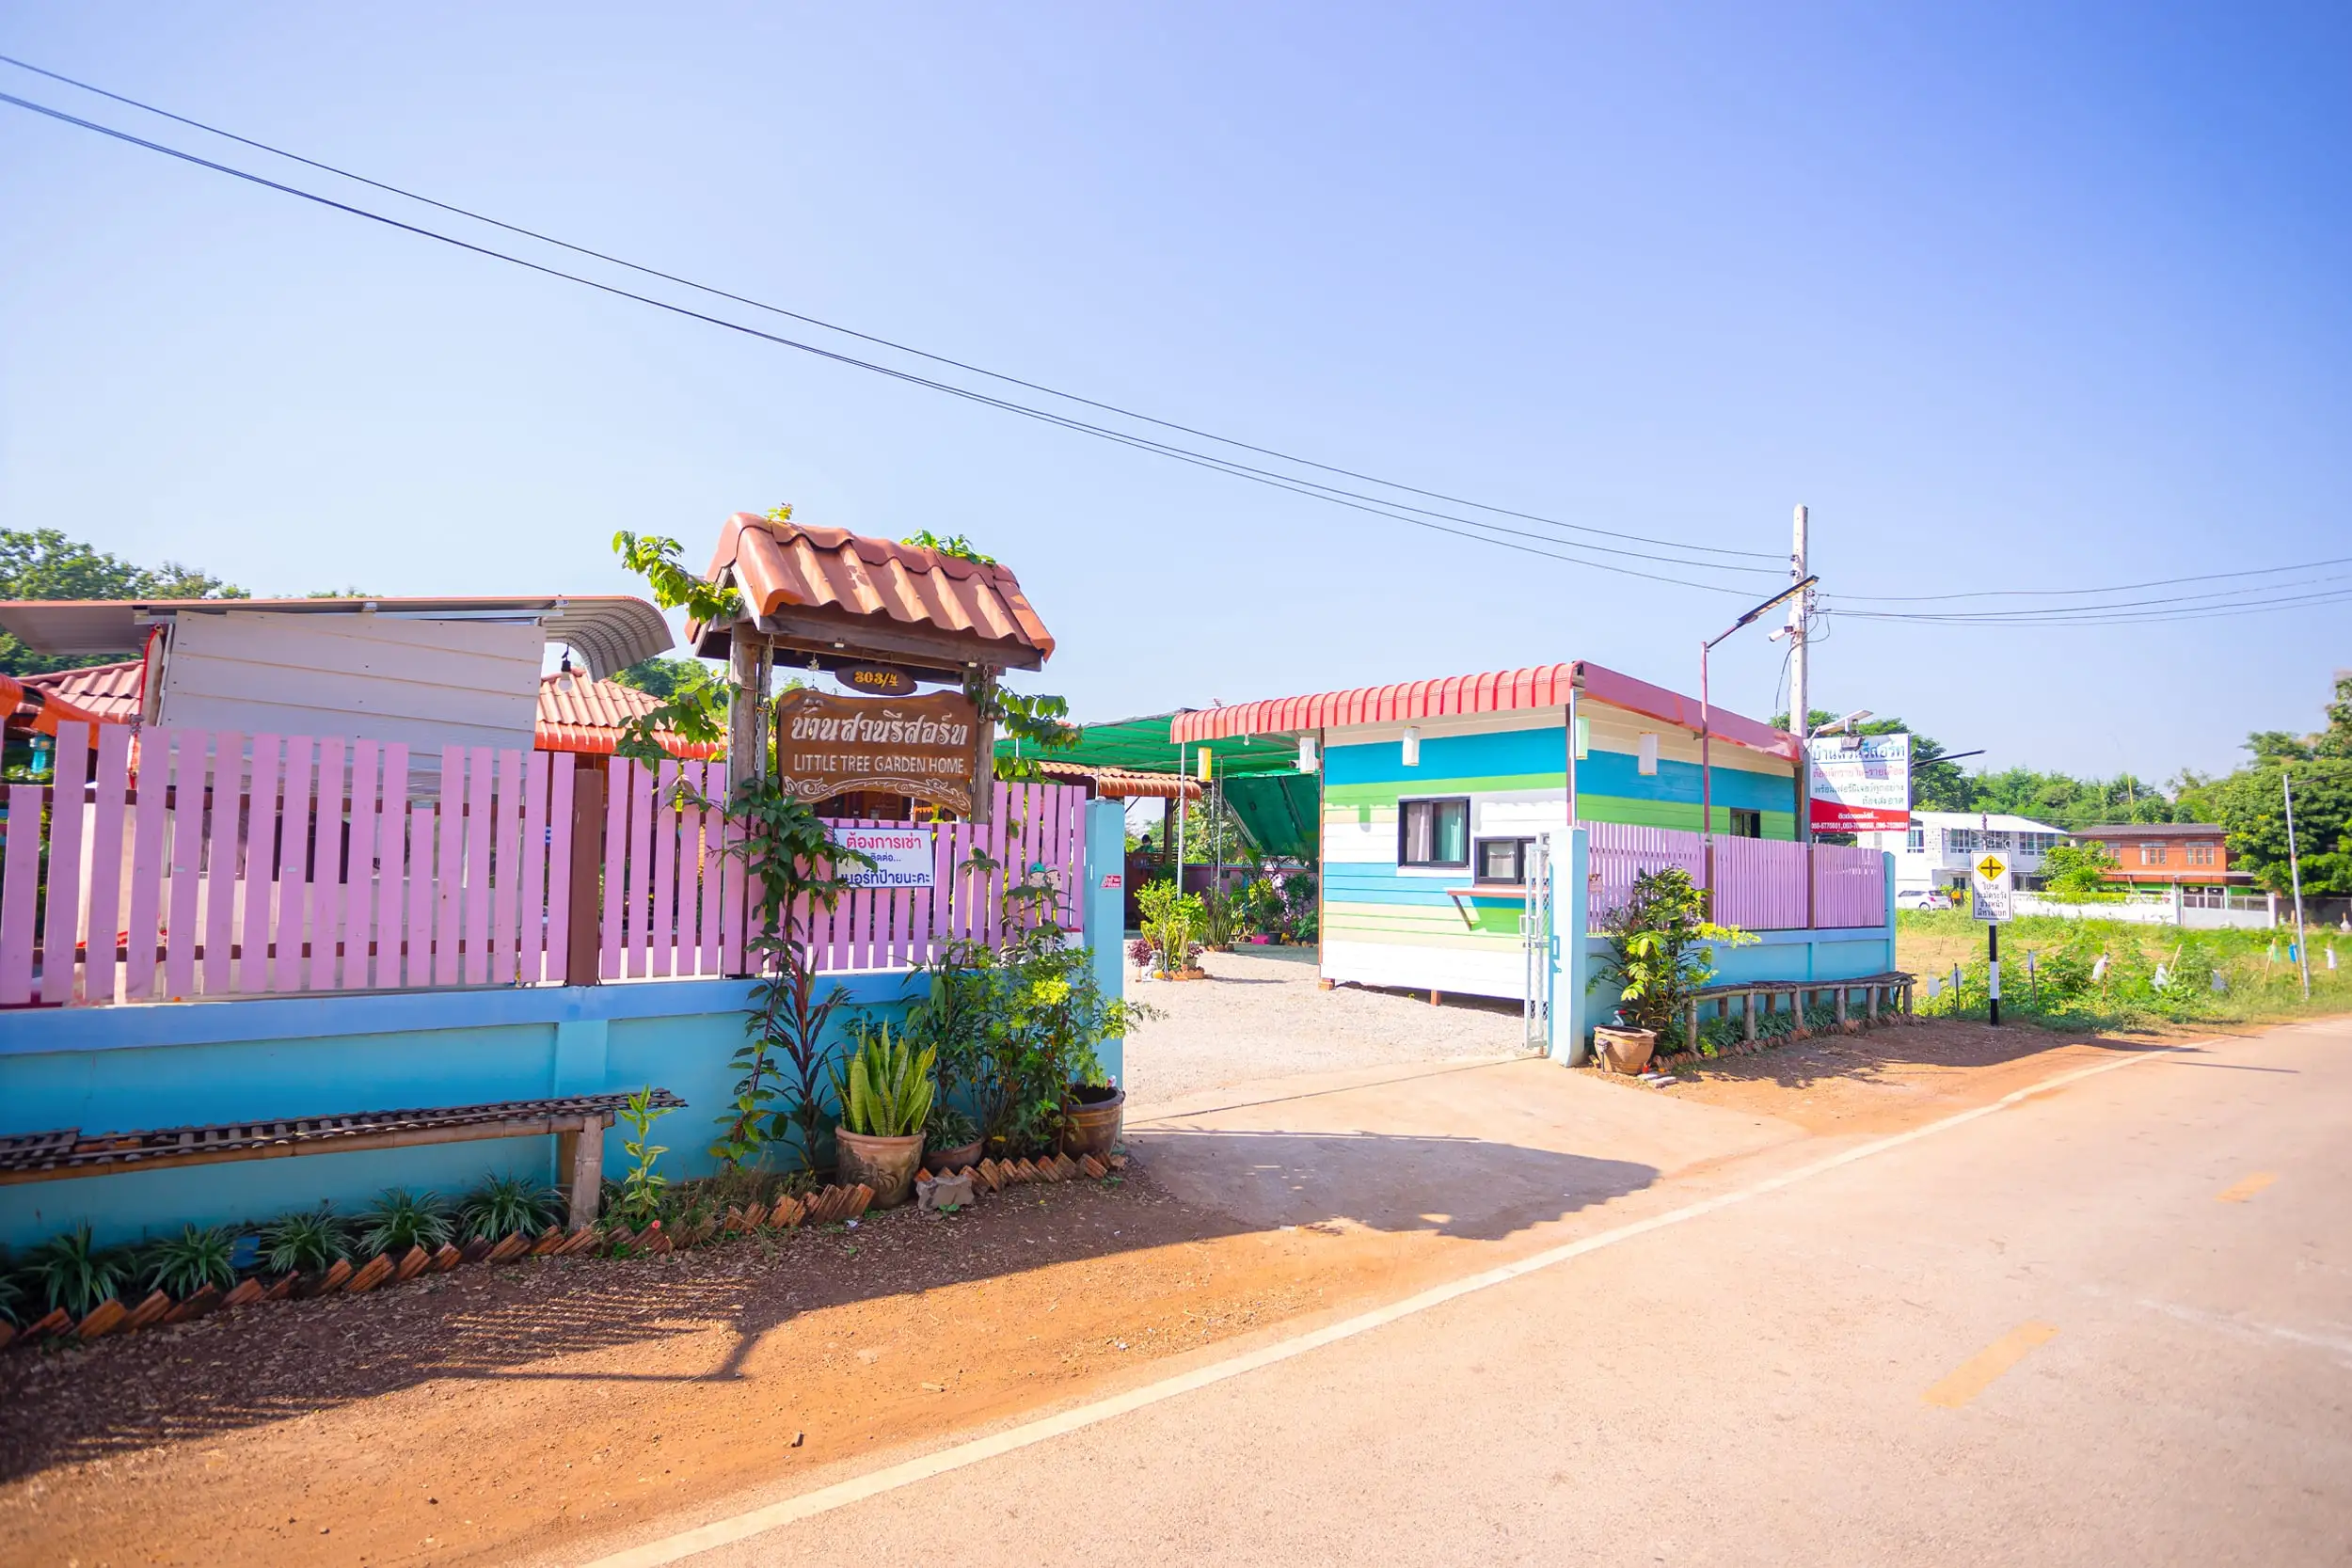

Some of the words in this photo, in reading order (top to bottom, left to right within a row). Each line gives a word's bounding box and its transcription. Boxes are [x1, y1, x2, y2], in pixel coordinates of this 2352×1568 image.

[791, 706, 968, 746] บ้านสวนรีสอร์ท
[794, 754, 836, 771] LITTLE
[840, 755, 870, 771] TREE
[874, 756, 926, 773] GARDEN
[929, 758, 964, 774] HOME
[847, 832, 921, 849] ต้องการเช่า
